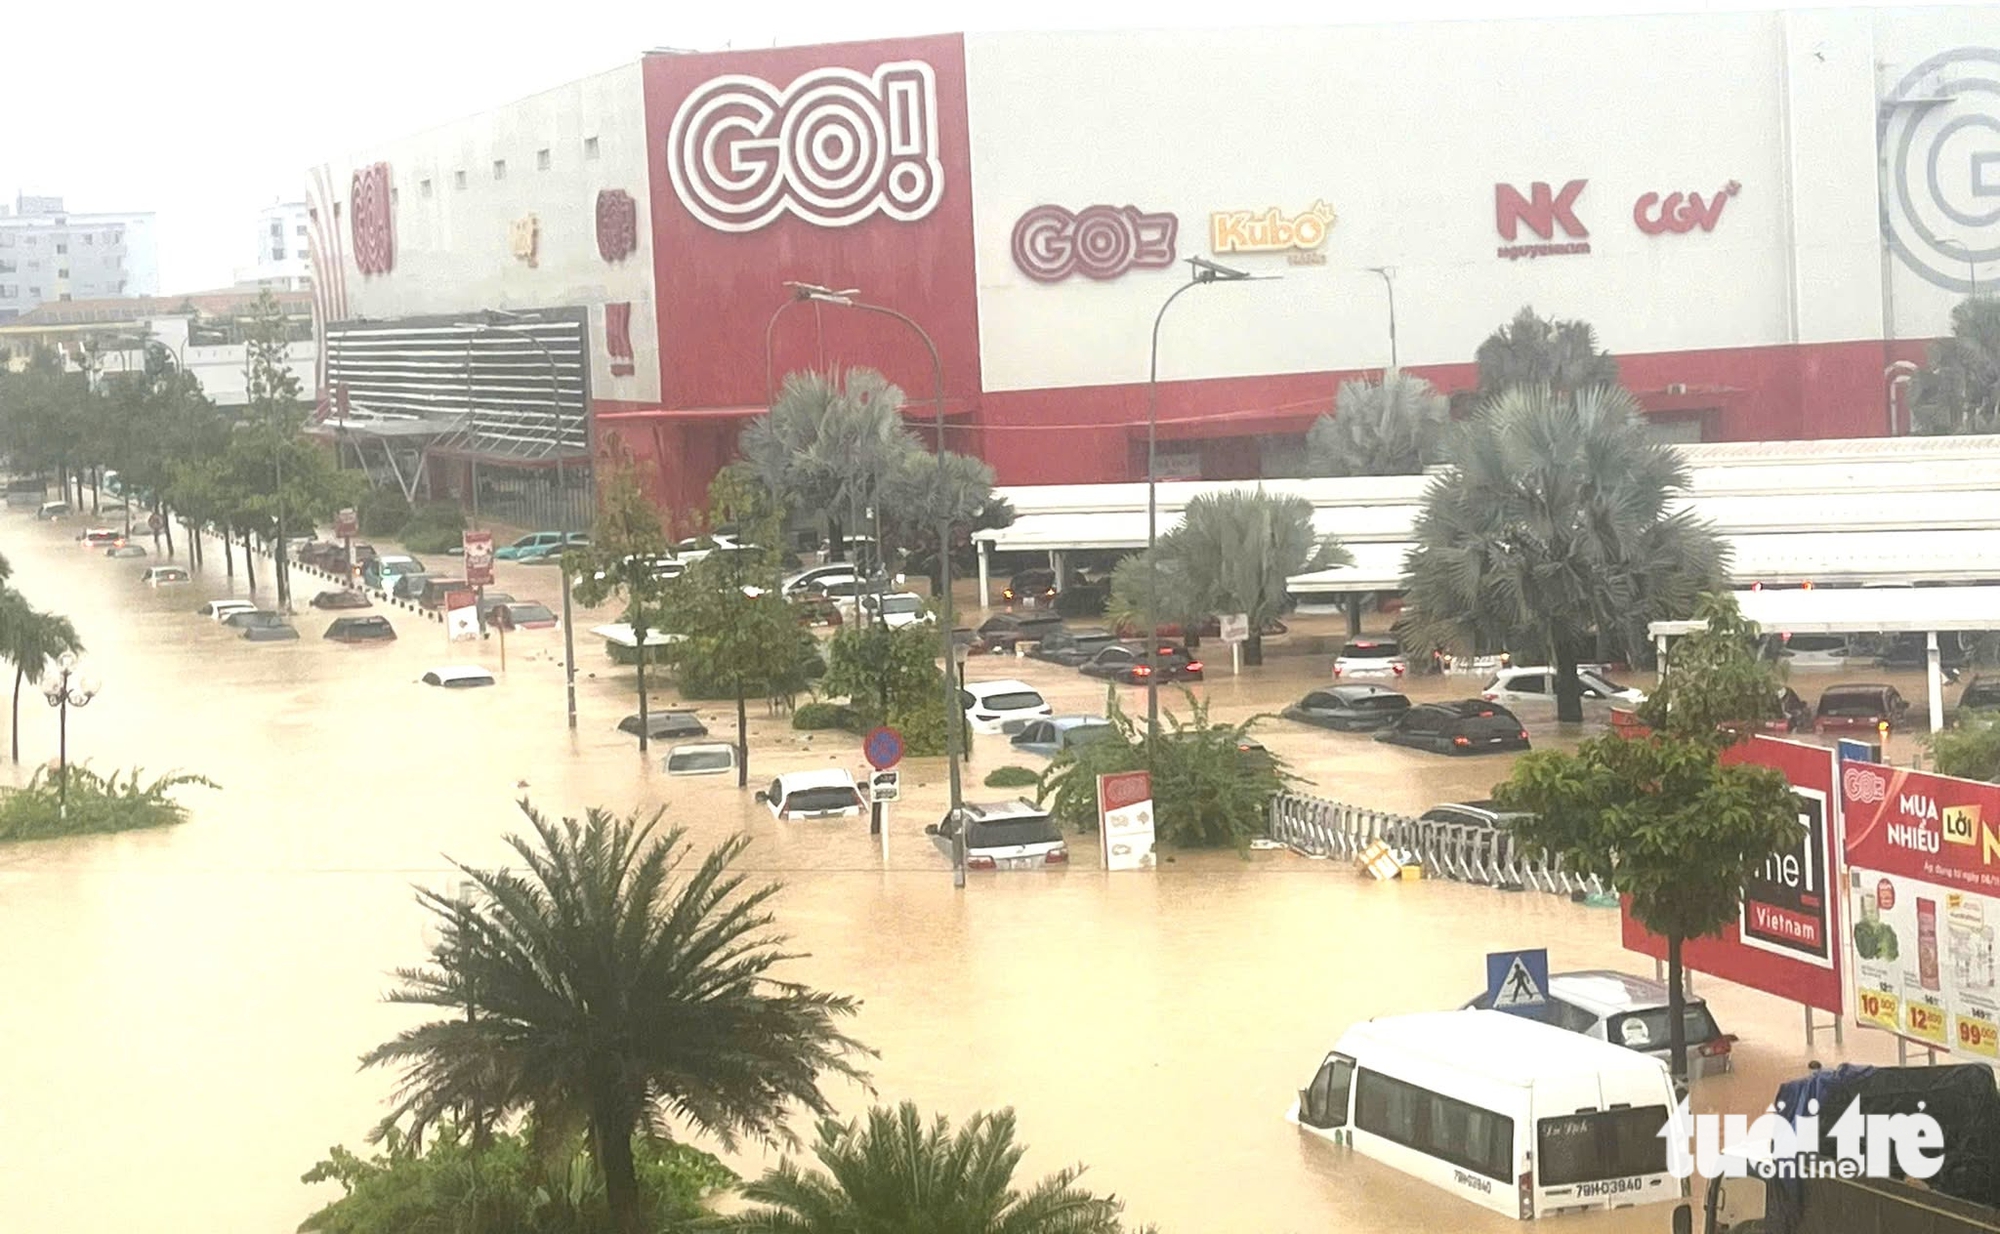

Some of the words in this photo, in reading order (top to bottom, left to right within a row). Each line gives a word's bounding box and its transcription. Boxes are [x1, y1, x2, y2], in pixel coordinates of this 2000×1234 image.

[667, 60, 945, 232] GO!
[1495, 178, 1590, 242] NK
[1633, 190, 1729, 236] CGV
[1010, 203, 1178, 285] GO!
[1900, 793, 1939, 820] MUA
[1756, 907, 1815, 941] Vietnam
[1862, 994, 1879, 1016] 10
[1910, 1006, 1928, 1031] 12
[1960, 1021, 1981, 1045] 99
